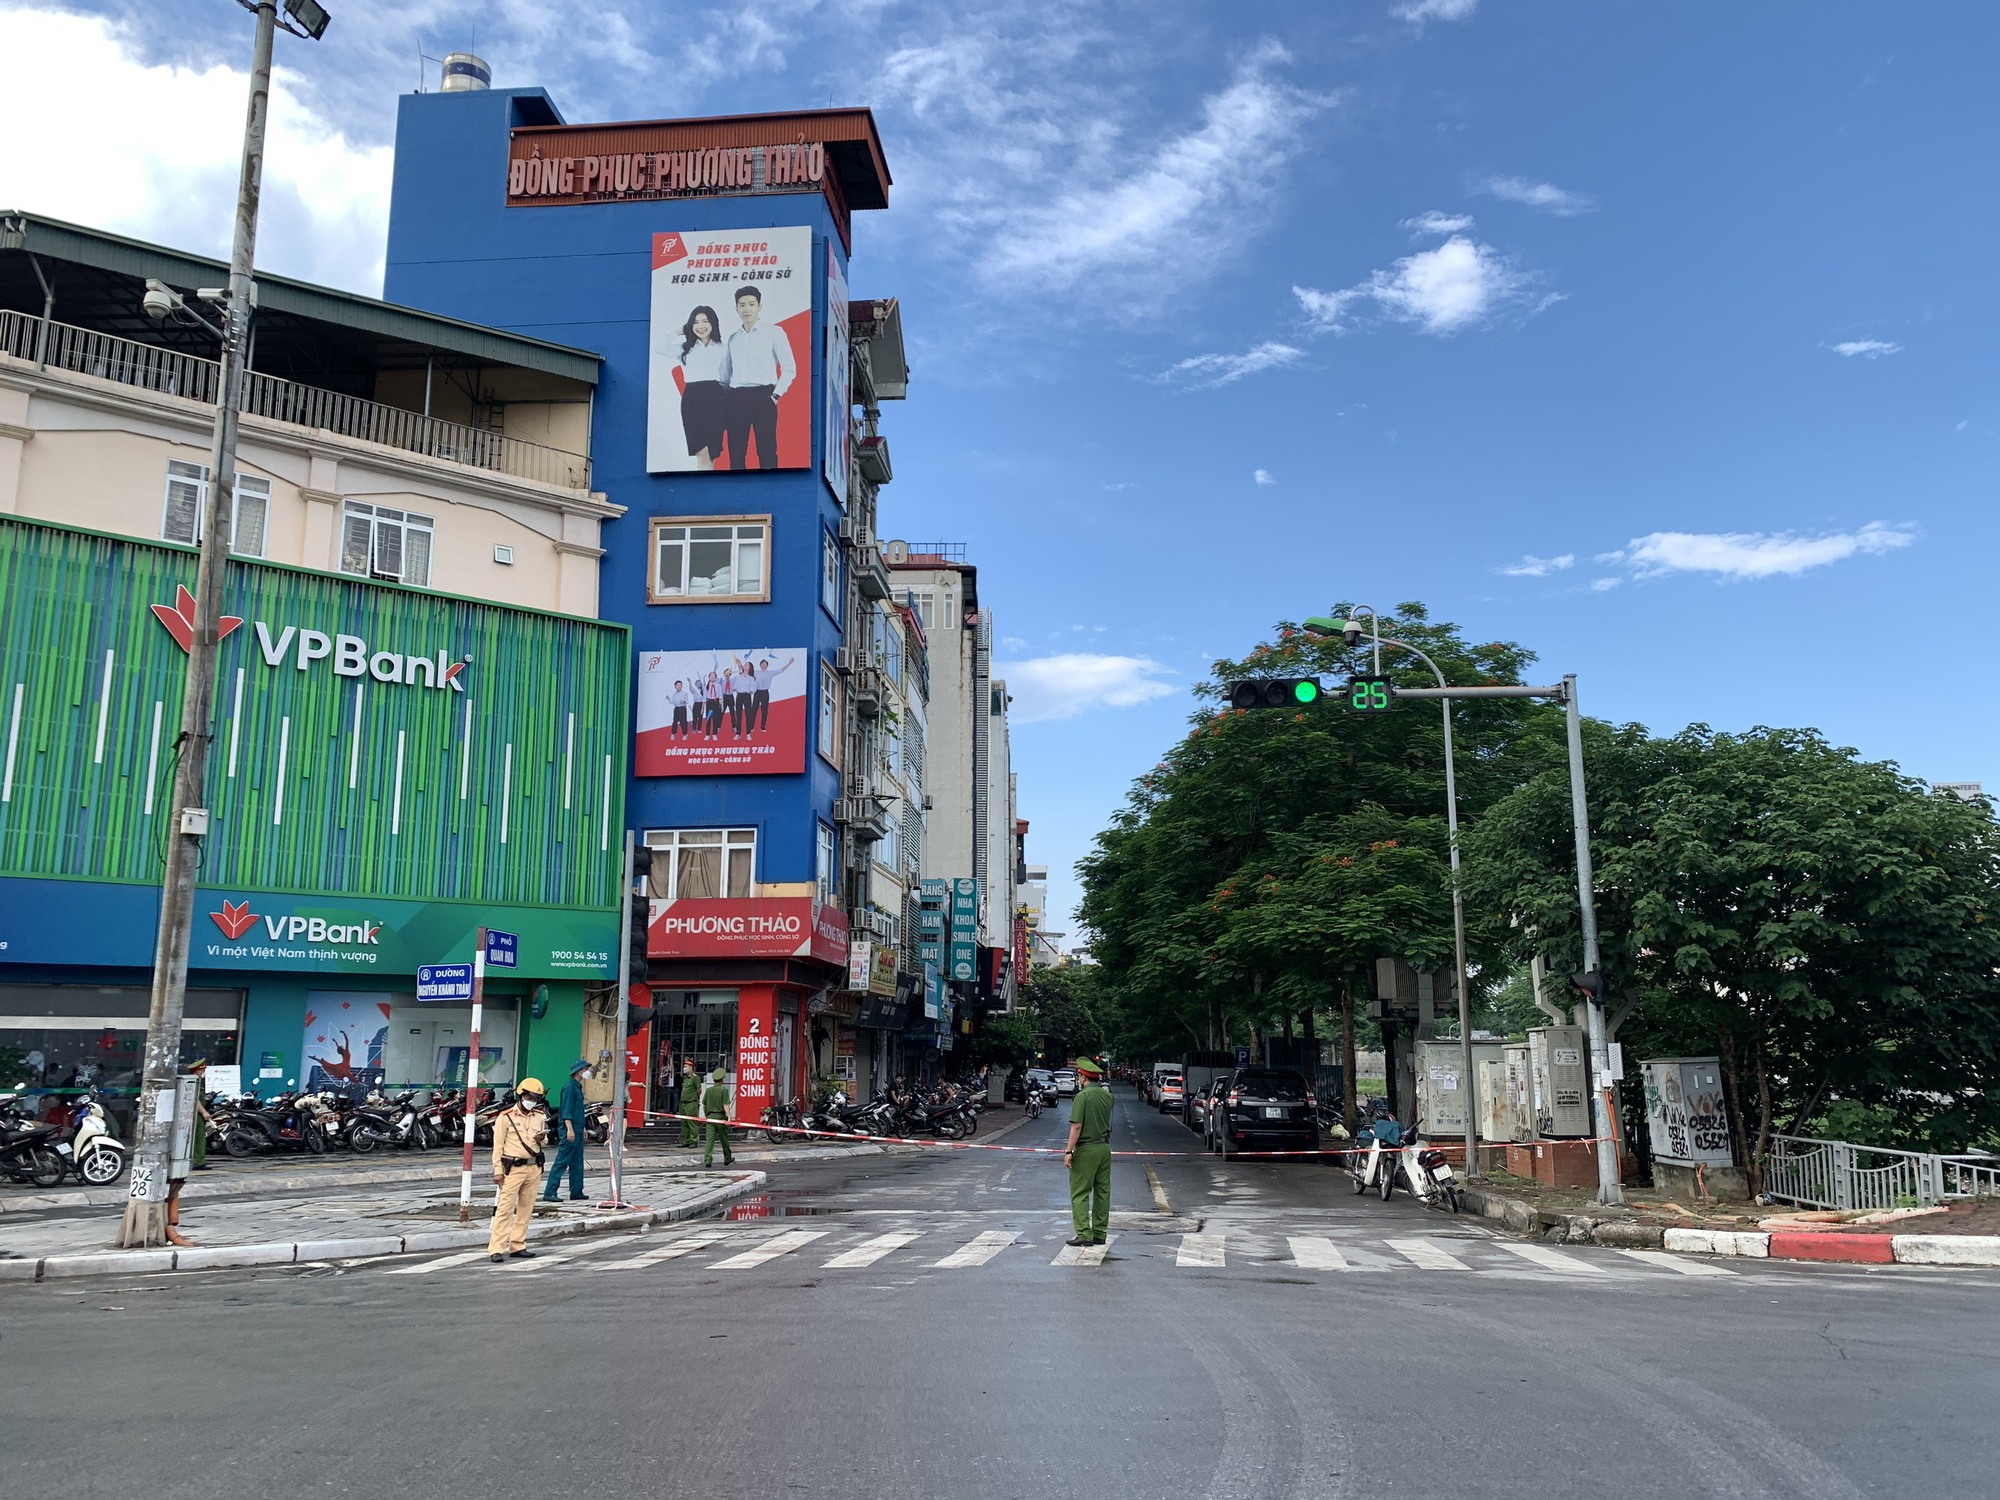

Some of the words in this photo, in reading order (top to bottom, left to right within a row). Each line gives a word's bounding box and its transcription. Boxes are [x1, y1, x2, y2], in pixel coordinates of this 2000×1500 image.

[509, 143, 574, 196] ĐỒNG
[583, 153, 646, 198] PHỤC
[655, 146, 752, 189] PHƯƠNG
[763, 133, 823, 184] THẢO
[254, 621, 466, 692] VPBank
[1352, 681, 1388, 709] 25
[957, 897, 973, 909] NHA
[665, 915, 745, 934] PHƯƠNG
[747, 912, 801, 933] THẢO
[954, 914, 975, 926] KHOA
[264, 915, 380, 945] VPBank
[952, 931, 976, 943] SMILE
[500, 936, 513, 946] PHỐ
[207, 945, 219, 955] Vì
[222, 946, 247, 959] một
[251, 946, 274, 960] Việt
[277, 948, 306, 958] Nam
[309, 948, 338, 961] thịnh
[341, 950, 377, 963] vượng
[551, 951, 572, 959] 1900
[573, 951, 585, 960] 54
[586, 951, 597, 960] 54
[598, 952, 608, 961] 15
[956, 948, 972, 960] ONE
[1016, 931, 1024, 982] AGRIBANK
[435, 967, 465, 978] ĐƯỜNG
[749, 1018, 760, 1033] 2
[739, 1034, 769, 1049] ĐỒNG
[739, 1051, 769, 1067] PHỤC
[1238, 1050, 1248, 1062] P
[742, 1067, 764, 1083] HỌC
[739, 1084, 766, 1098] SINH
[130, 1181, 147, 1198] 28
